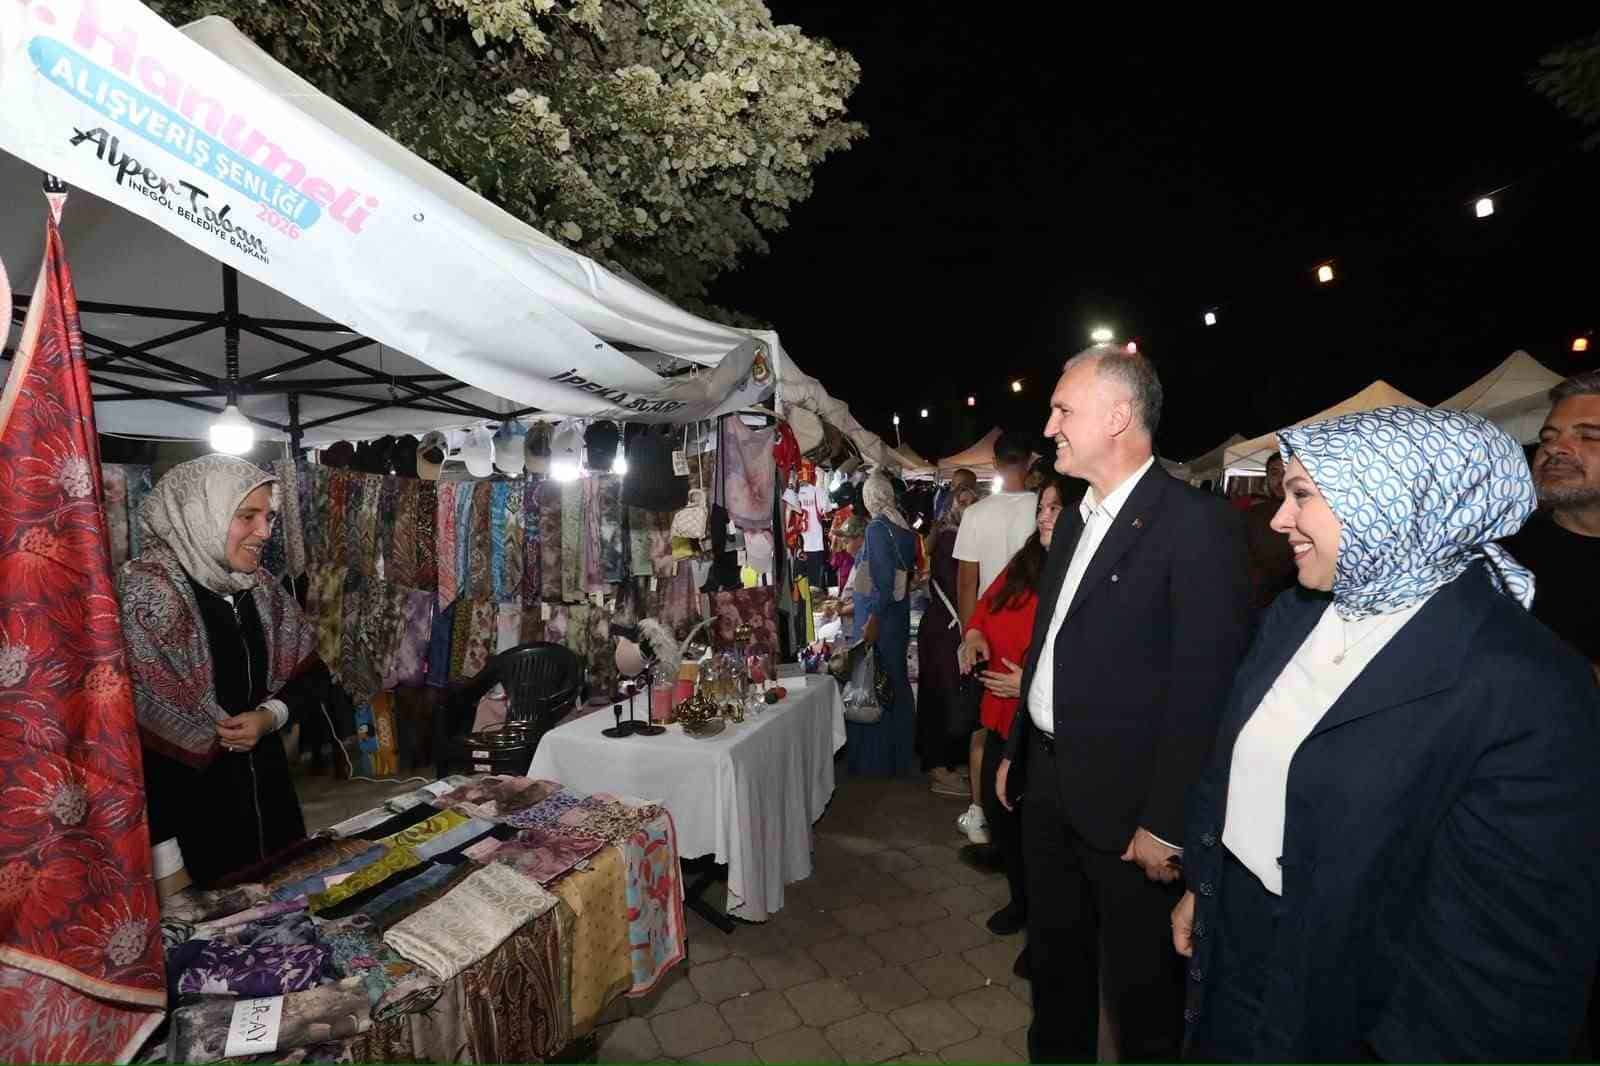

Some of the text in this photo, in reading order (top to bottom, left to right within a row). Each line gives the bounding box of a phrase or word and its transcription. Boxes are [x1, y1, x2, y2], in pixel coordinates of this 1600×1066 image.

[51, 57, 306, 219] ALIŞVERİŞ ŞENLİĞİ
[70, 127, 268, 255] Alper Taban
[176, 207, 226, 240] BELEDİYE
[256, 203, 300, 240] 2026
